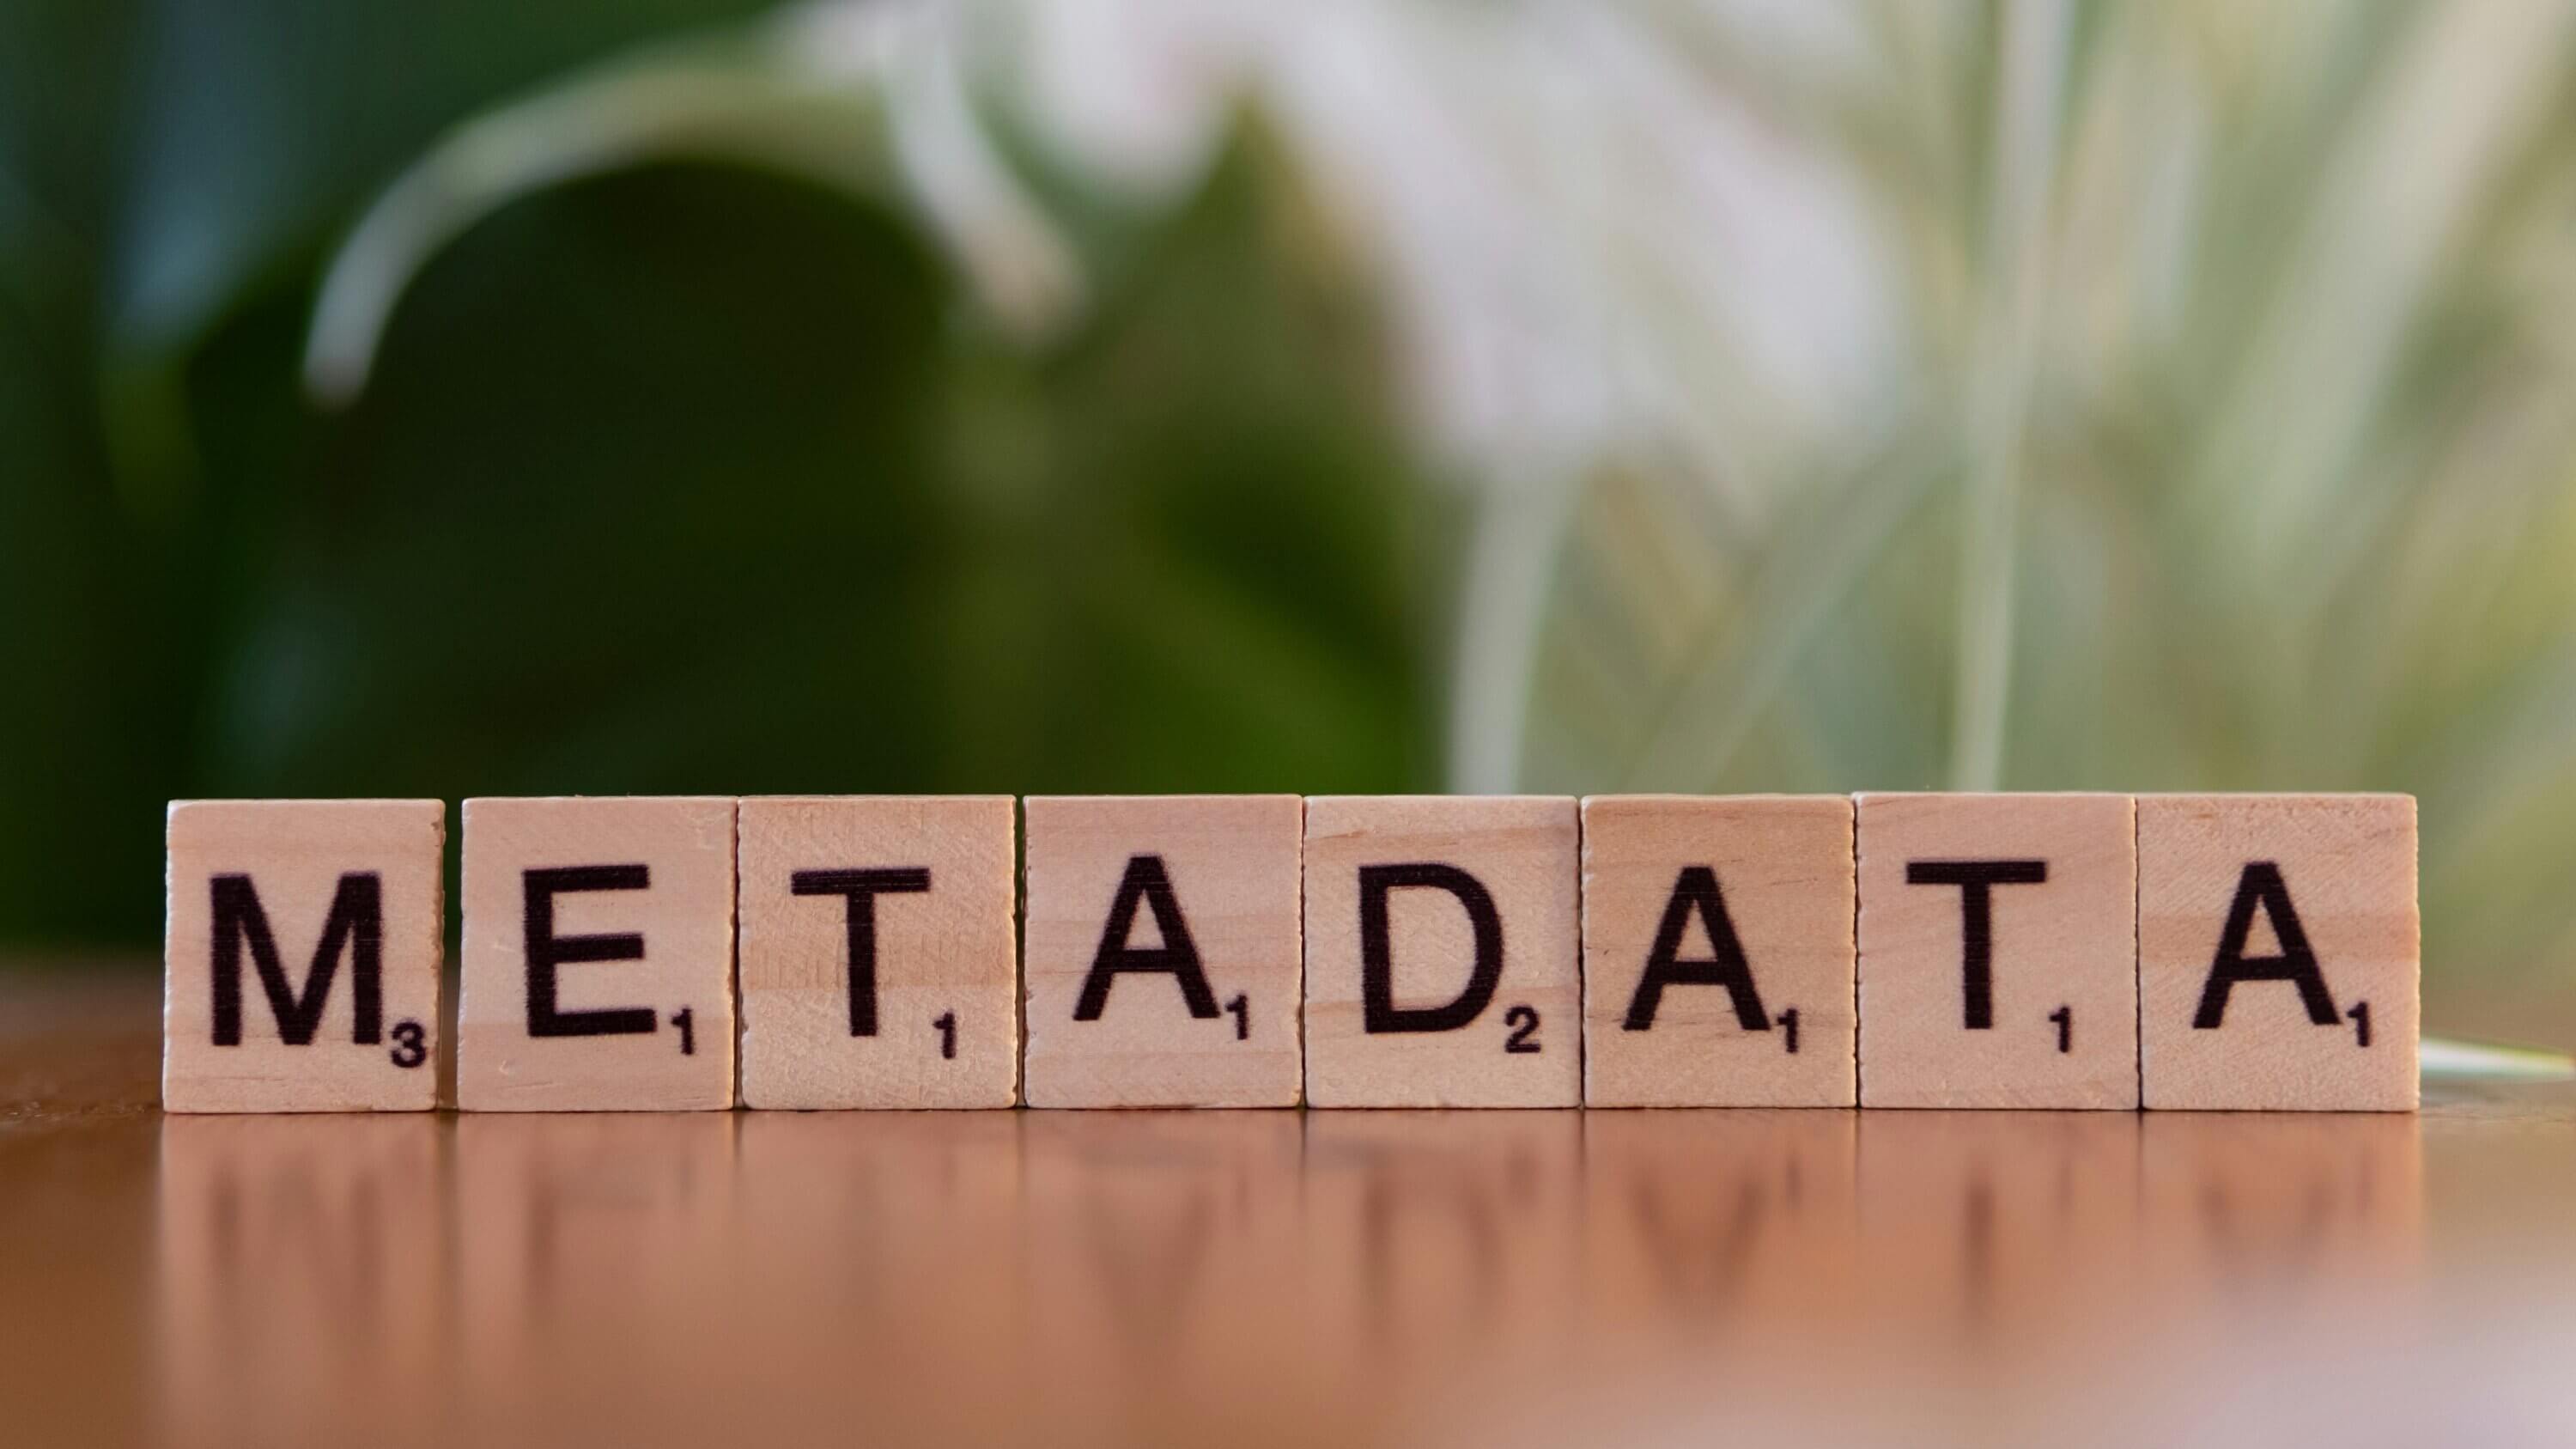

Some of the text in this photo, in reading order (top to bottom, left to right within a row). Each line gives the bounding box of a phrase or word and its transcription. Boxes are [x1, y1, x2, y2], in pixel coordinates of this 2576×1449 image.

[671, 1008, 695, 1056] 1
[933, 1013, 956, 1060] 1
[1225, 994, 1249, 1040] 1
[1504, 1006, 1541, 1054] 2
[1776, 1008, 1800, 1054] 1
[2049, 1006, 2072, 1053] 1
[2347, 1002, 2371, 1048] 1
[391, 1021, 428, 1068] 3
